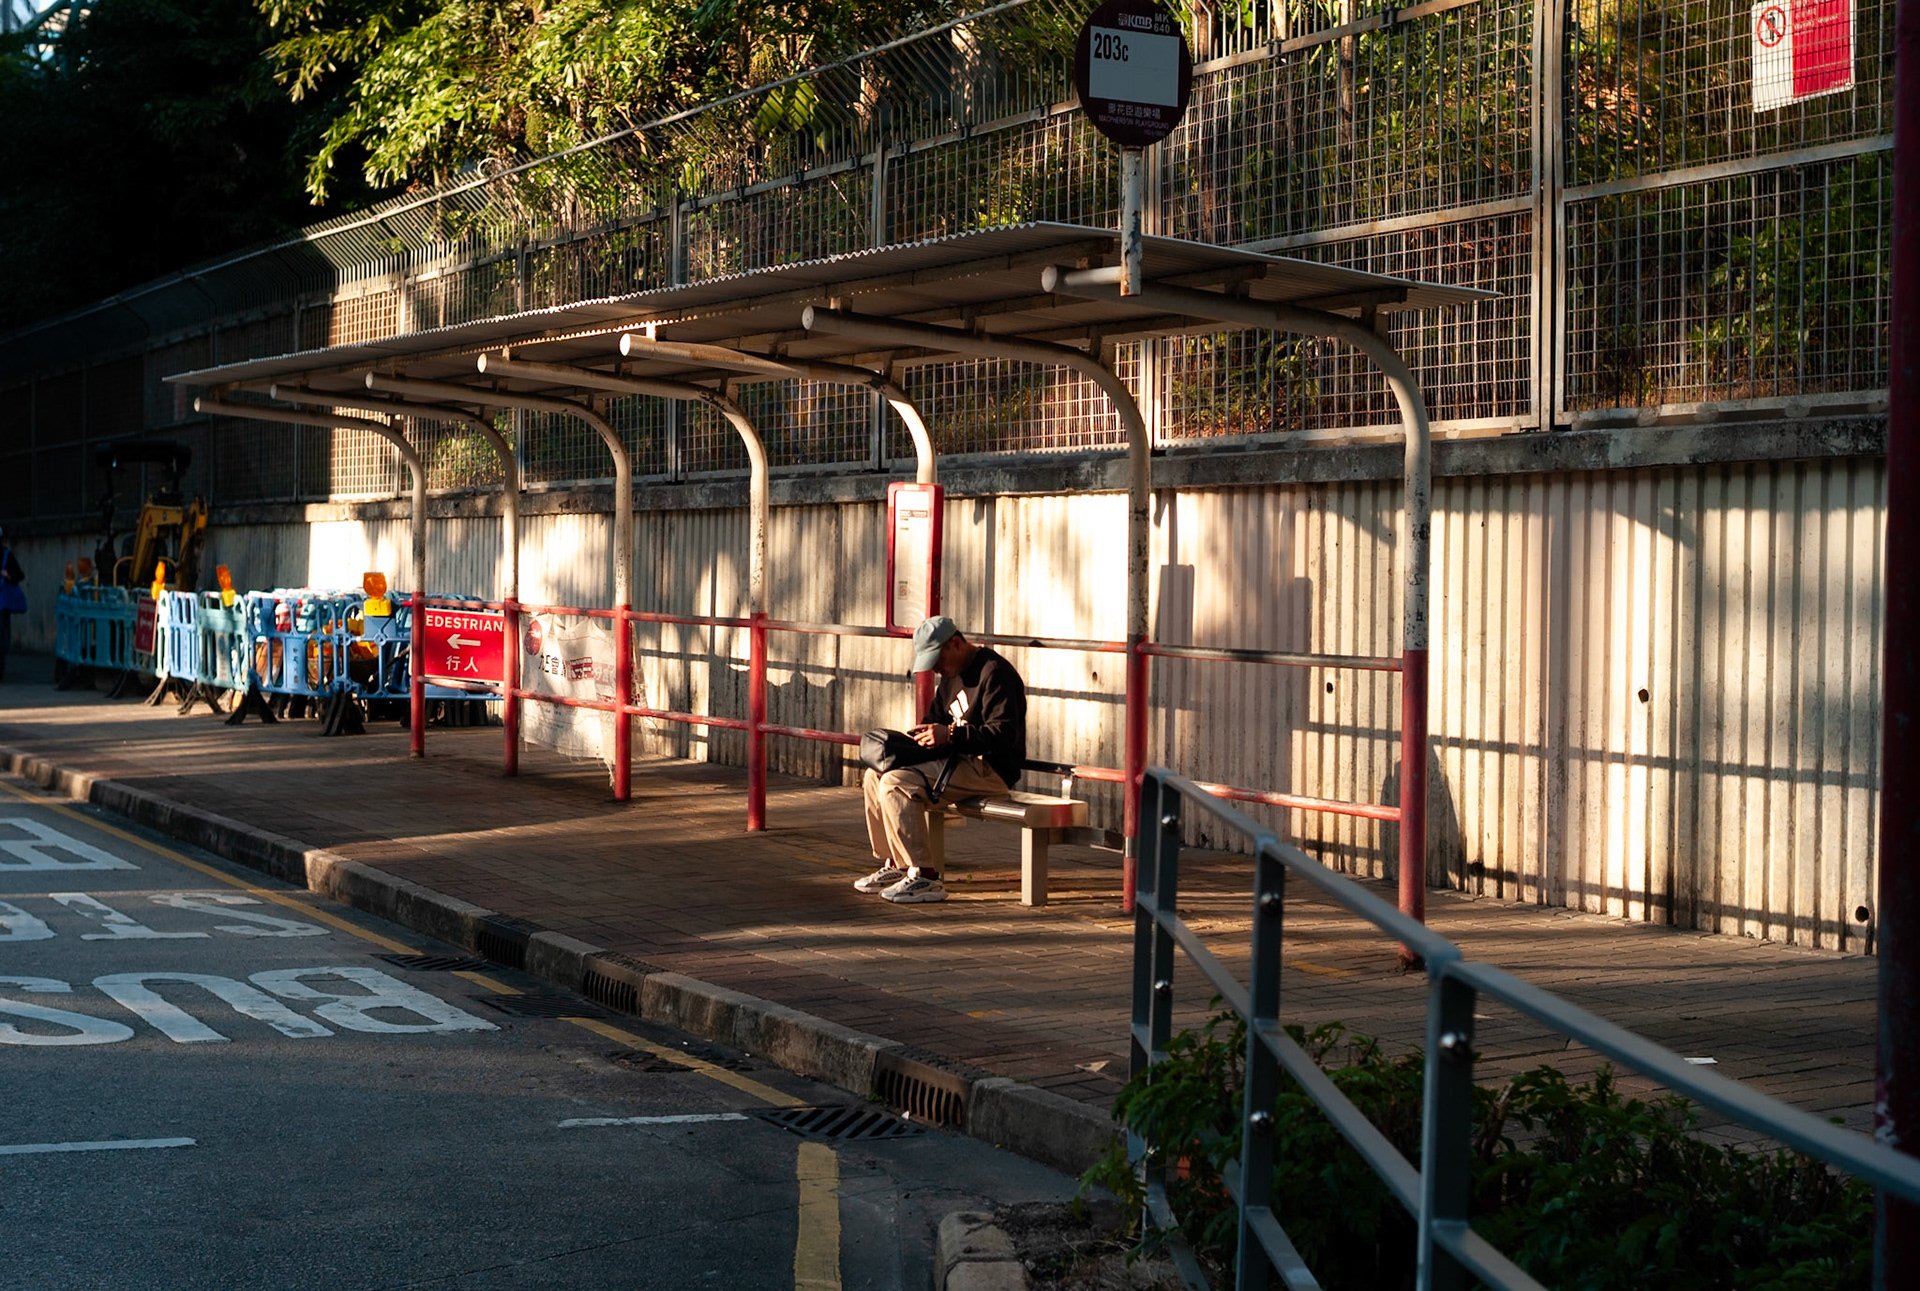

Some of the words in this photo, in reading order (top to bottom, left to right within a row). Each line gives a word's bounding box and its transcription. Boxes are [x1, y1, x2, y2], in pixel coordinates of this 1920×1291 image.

[1154, 13, 1170, 24] MK
[1154, 23, 1171, 34] 640
[426, 614, 505, 633] EDESTRIAN
[445, 655, 479, 673] 行人
[0, 966, 501, 1047] BUS
